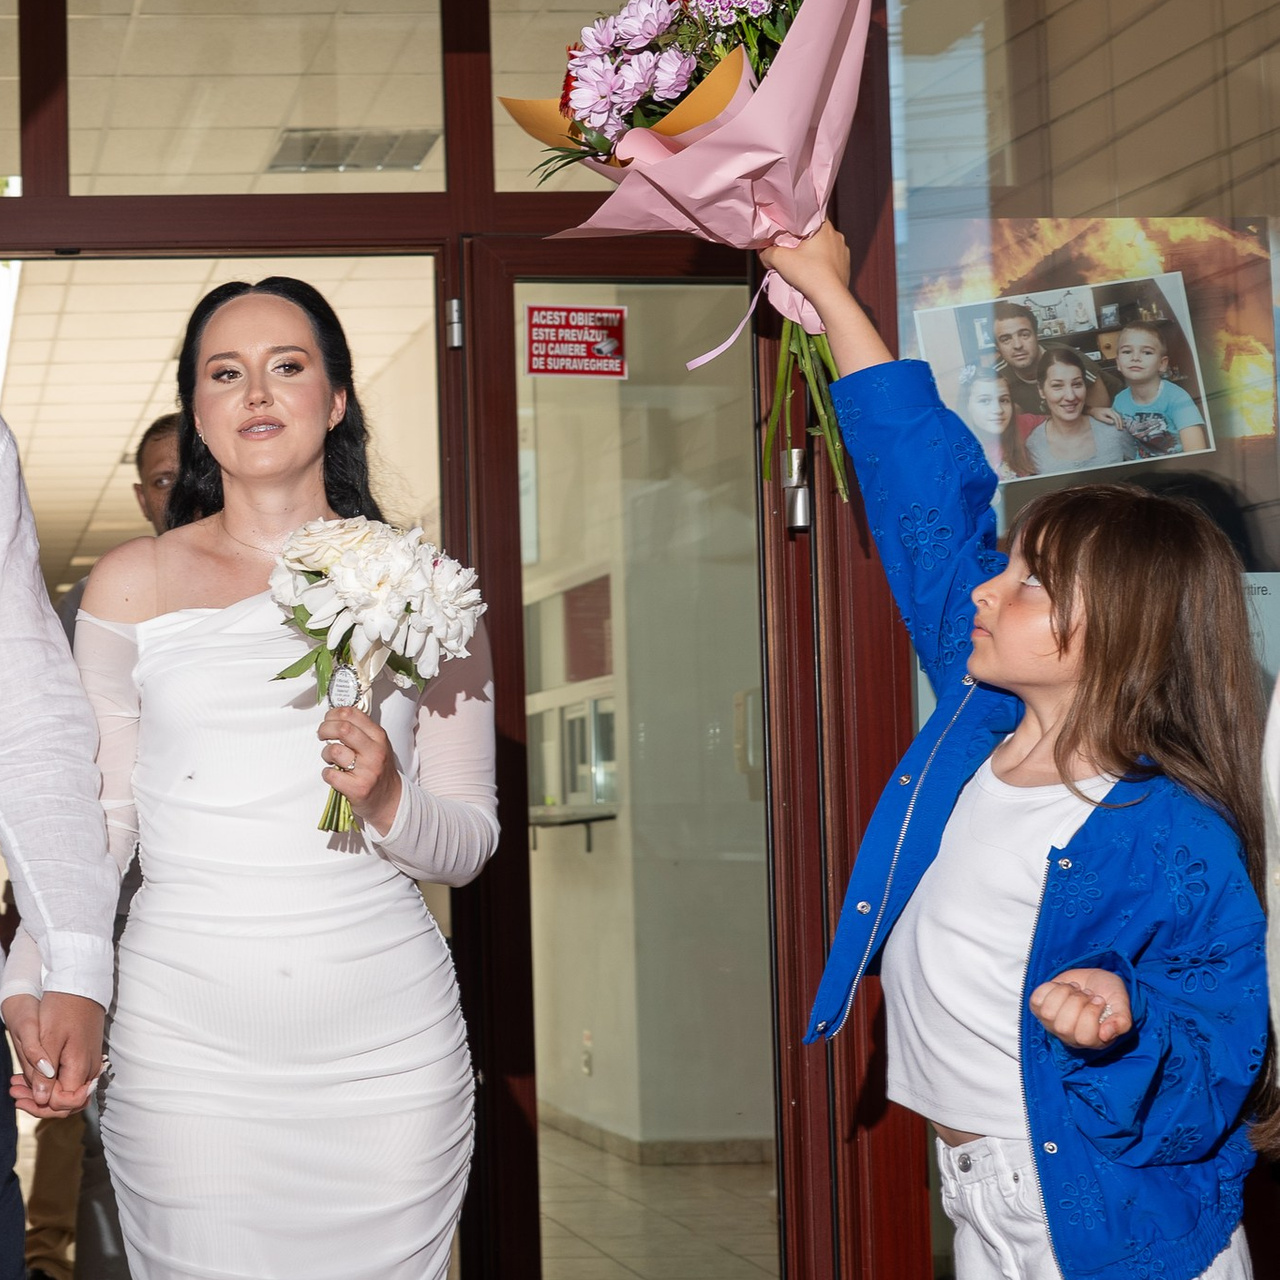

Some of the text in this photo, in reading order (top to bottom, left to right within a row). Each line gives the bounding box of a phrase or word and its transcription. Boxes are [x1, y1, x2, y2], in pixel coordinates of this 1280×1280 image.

[532, 310, 621, 326] ACEST OBIECTIV
[532, 327, 609, 342] ESTE PREVĂZUT
[532, 342, 587, 356] CU CAMERE
[532, 356, 621, 372] DE SUPRAVEGHERE
